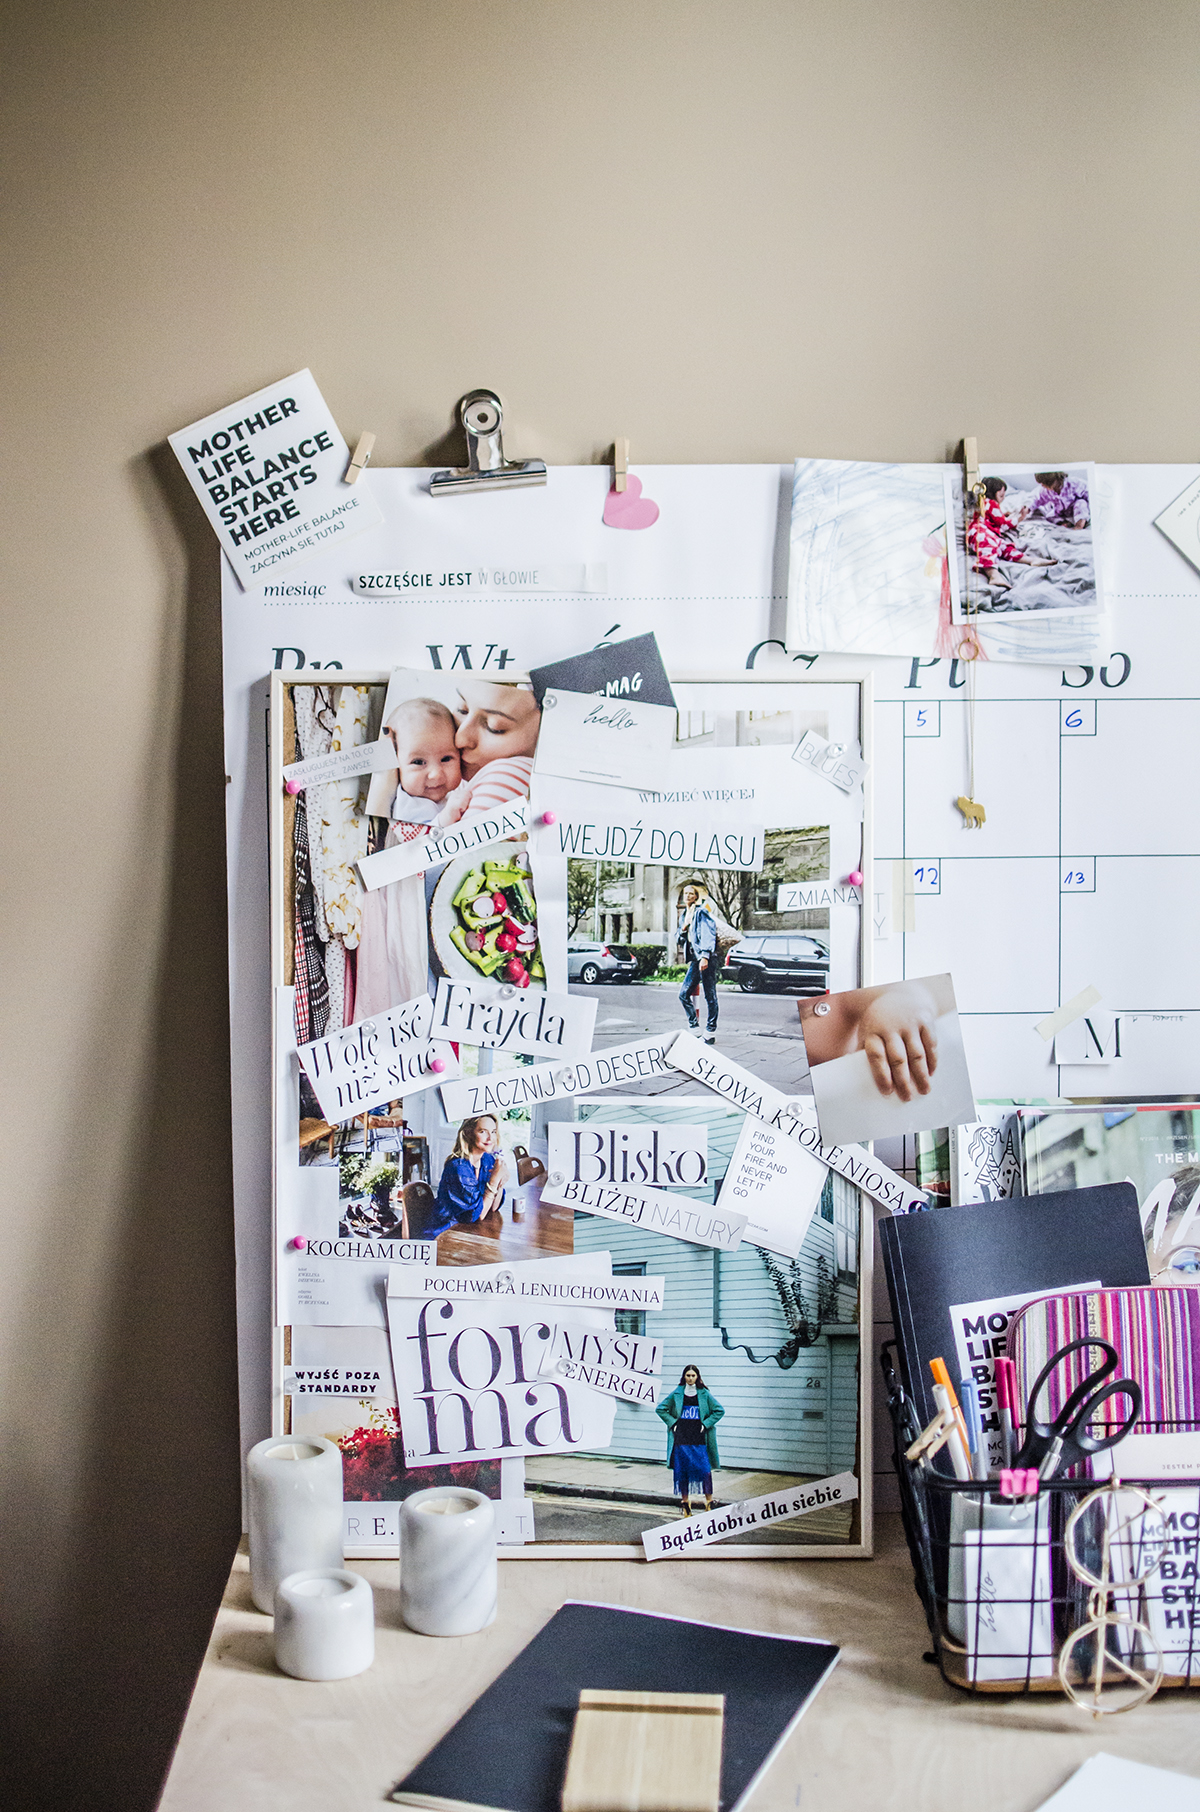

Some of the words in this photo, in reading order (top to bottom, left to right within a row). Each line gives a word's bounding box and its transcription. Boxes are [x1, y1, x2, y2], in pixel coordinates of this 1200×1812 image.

[187, 397, 300, 464] MOTHER
[197, 444, 255, 485] LIFE
[208, 430, 334, 506] BALANCE
[219, 464, 318, 526] STARTS
[229, 499, 301, 547] HERE
[244, 522, 311, 561] MOTHER-LIFE
[312, 498, 360, 528] BALANCE
[250, 545, 297, 574] ZACZYNA
[299, 538, 316, 552] SIĘ
[314, 521, 346, 542] TUTAJ
[263, 580, 327, 599] miesiąc
[359, 570, 433, 591] SZCZĘŚCIE
[439, 572, 472, 586] JEST
[478, 571, 488, 585] W
[493, 570, 540, 586] GŁOWIE
[583, 704, 638, 730] hello
[916, 709, 928, 727] 5
[1065, 709, 1083, 728] 6
[288, 757, 338, 779] ZASŁUGUJESZ
[339, 754, 351, 763] NA
[363, 746, 374, 756] CO
[799, 742, 859, 787] BLUES
[638, 788, 699, 803] WIDZIEĆ
[702, 788, 755, 803] WIĘCEJ
[424, 807, 528, 863] HOLIDAY
[559, 820, 643, 858] WEJDŹ
[650, 829, 685, 861] DO
[692, 832, 756, 867] LASU
[914, 867, 938, 885] 12
[1063, 871, 1085, 885] 13
[786, 886, 859, 908] ZMIANA
[440, 983, 566, 1049] Frajda
[310, 1026, 381, 1079] Wolę
[387, 1004, 425, 1048] iść
[1083, 1016, 1122, 1058] M
[334, 1065, 381, 1108] niż
[468, 1070, 556, 1114] ZACZNIJ
[562, 1062, 591, 1093] OD
[691, 1057, 764, 1120] SŁOWA,
[768, 1106, 844, 1166] KTÓRE
[749, 1141, 775, 1158] YOUR
[752, 1130, 775, 1145] FIND
[740, 1164, 773, 1182] NEVER
[744, 1152, 766, 1167] FIRE
[766, 1161, 788, 1175] AND
[1154, 1152, 1184, 1164] THE
[732, 1186, 749, 1198] GO
[736, 1175, 755, 1188] LET
[755, 1181, 766, 1192] IT
[561, 1183, 648, 1224] BLIŻEJ
[650, 1203, 741, 1245] NATURY
[306, 1240, 395, 1260] KOCHAM
[399, 1243, 431, 1265] CIĘ
[423, 1278, 516, 1295] POCHWAŁA
[520, 1282, 661, 1304] LENIUCHOWANIA
[406, 1297, 552, 1395] for
[560, 1331, 657, 1374] MYŚL!
[295, 1369, 339, 1380] WYJŚĆ
[345, 1371, 380, 1380] POZA
[299, 1384, 377, 1393] STANDARDY
[565, 1362, 656, 1404] ENERGIA
[806, 1377, 821, 1389] 2a
[414, 1381, 584, 1457] ma
[659, 1523, 704, 1552] Bądź
[706, 1512, 758, 1537] dobra
[760, 1502, 790, 1522] dla
[792, 1486, 843, 1512] siebie
